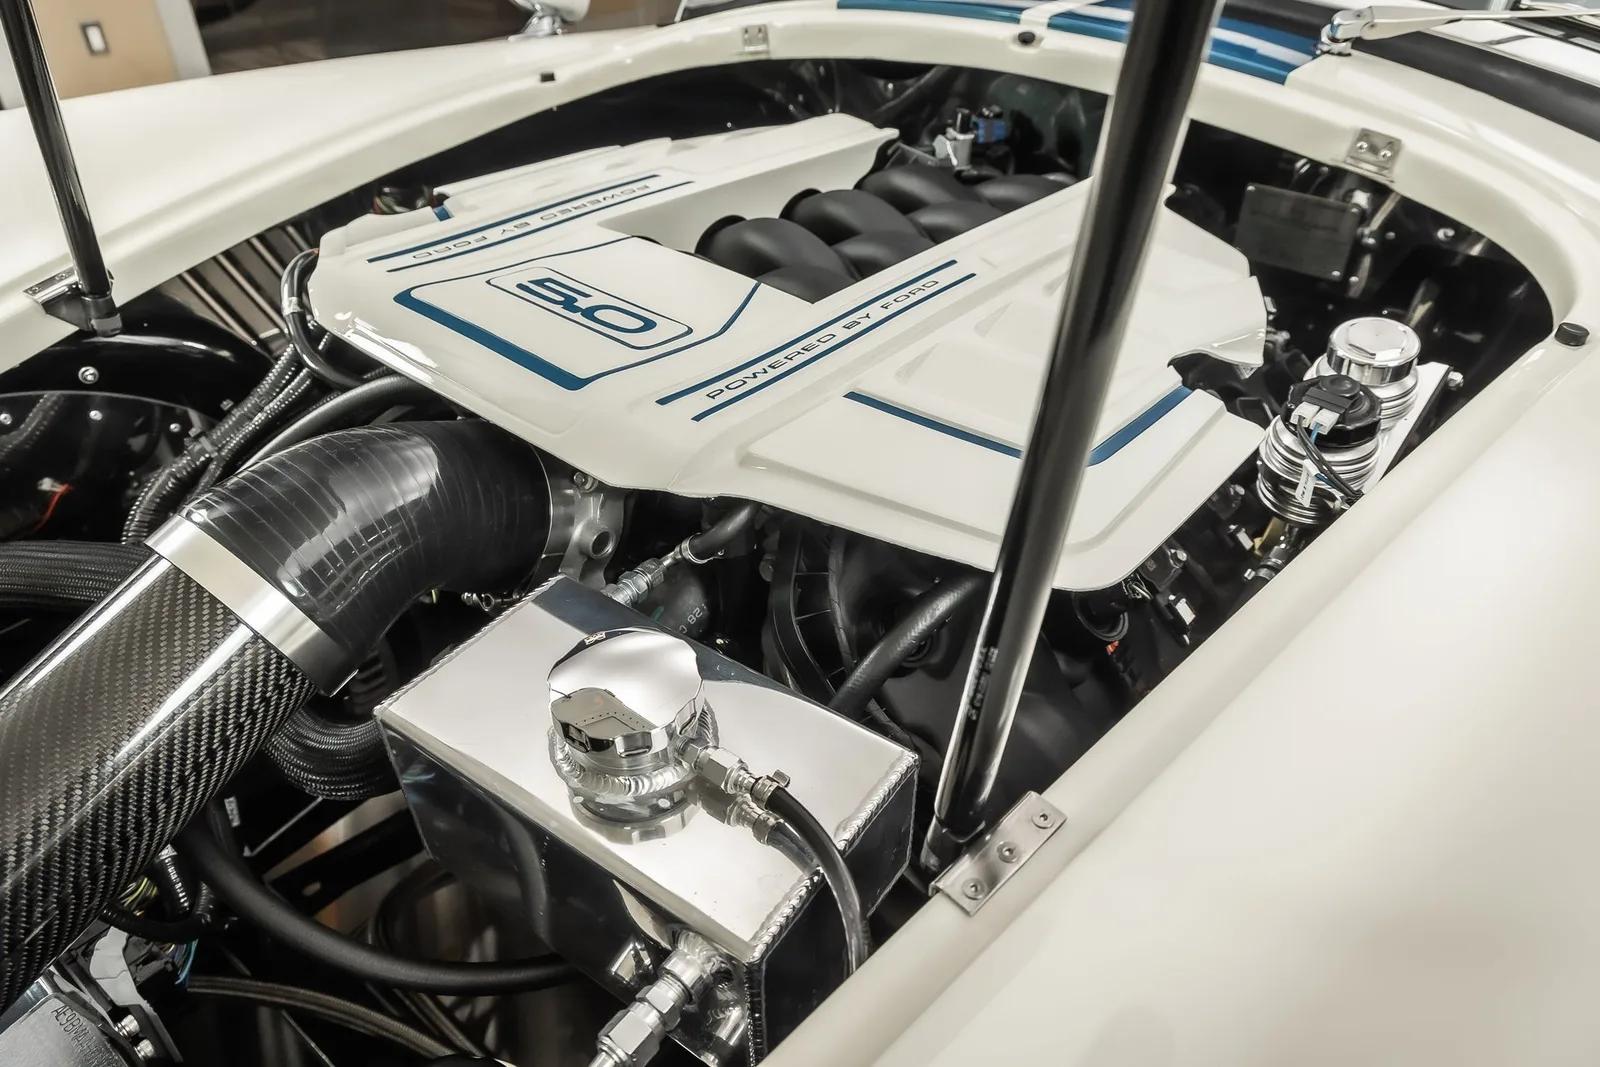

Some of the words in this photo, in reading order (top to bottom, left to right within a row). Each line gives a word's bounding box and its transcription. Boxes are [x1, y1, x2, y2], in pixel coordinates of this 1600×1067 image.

[540, 184, 650, 221] POWERED
[500, 221, 531, 235] BY
[412, 235, 488, 260] FORD
[515, 277, 658, 334] 5.0
[705, 332, 837, 400] POWERED
[842, 312, 872, 330] BY
[880, 279, 940, 310] FORD
